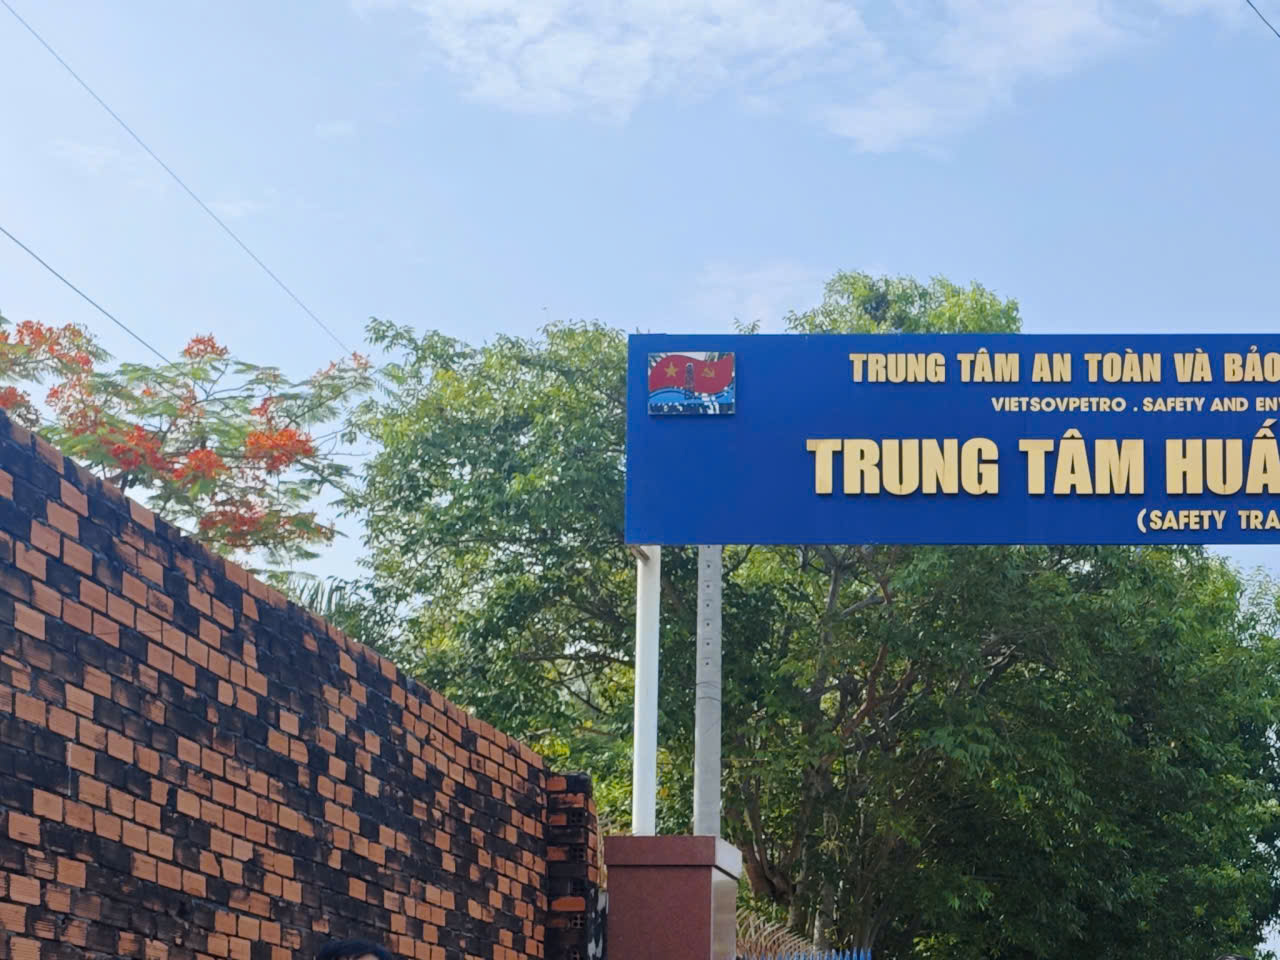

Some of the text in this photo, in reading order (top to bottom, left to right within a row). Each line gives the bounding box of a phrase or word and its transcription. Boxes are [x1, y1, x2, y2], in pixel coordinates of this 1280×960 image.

[850, 353, 946, 383] TRUNG
[957, 348, 1019, 382] TÂM
[1032, 353, 1072, 383] AN
[1085, 348, 1162, 382] TOÀN
[1174, 348, 1213, 382] VÀ
[991, 397, 1127, 412] VIETSOVPETRO
[1143, 397, 1205, 412] SAFETY
[1211, 397, 1249, 412] AND
[806, 437, 999, 496] TRUNG
[1019, 428, 1145, 496] TÂM
[1137, 508, 1227, 533] (SAFETY
